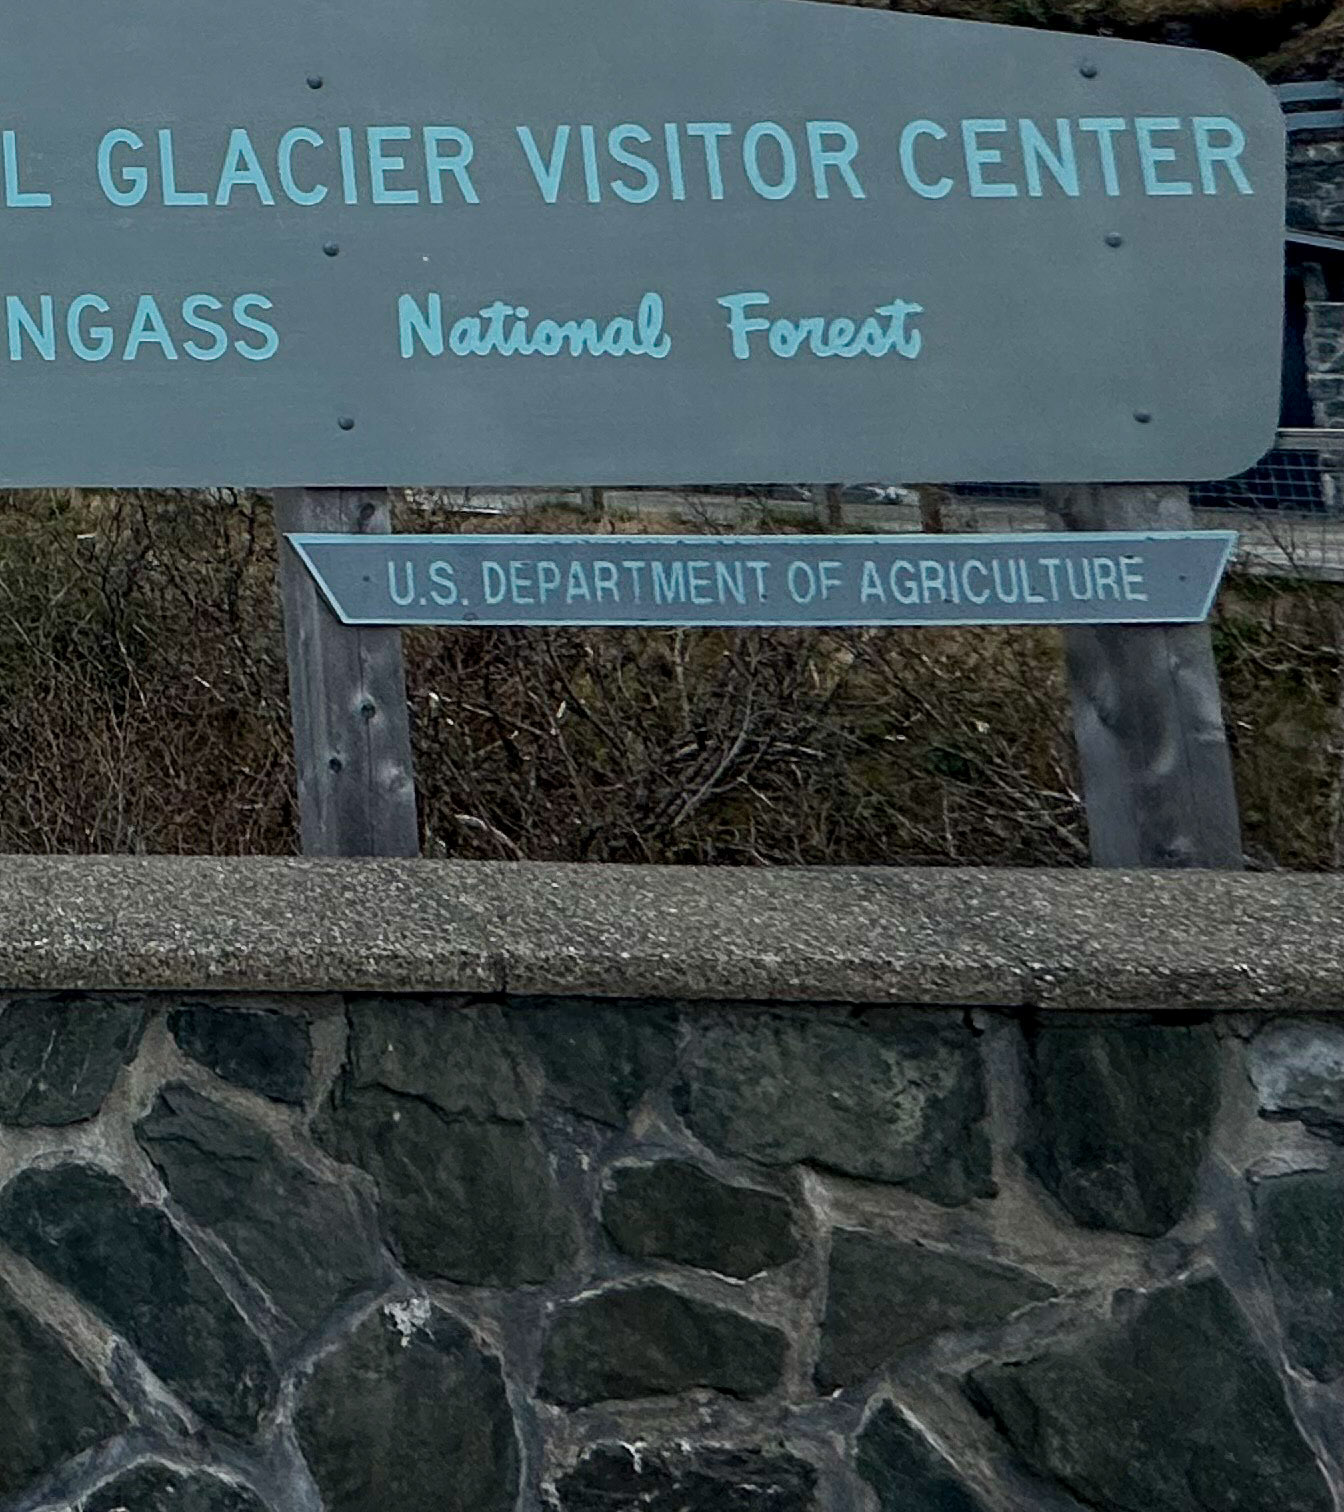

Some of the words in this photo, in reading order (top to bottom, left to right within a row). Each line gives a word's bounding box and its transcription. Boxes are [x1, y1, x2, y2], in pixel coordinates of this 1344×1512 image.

[98, 127, 480, 206] GLACIER
[516, 121, 866, 203] VISITOR
[899, 116, 1254, 199] CENTER
[398, 292, 671, 359] National
[719, 292, 924, 360] Forest
[388, 561, 469, 606] U.S.
[482, 560, 771, 605] DEPARTMENT
[788, 560, 843, 604] OF
[861, 556, 1148, 604] AGRICULTURE
